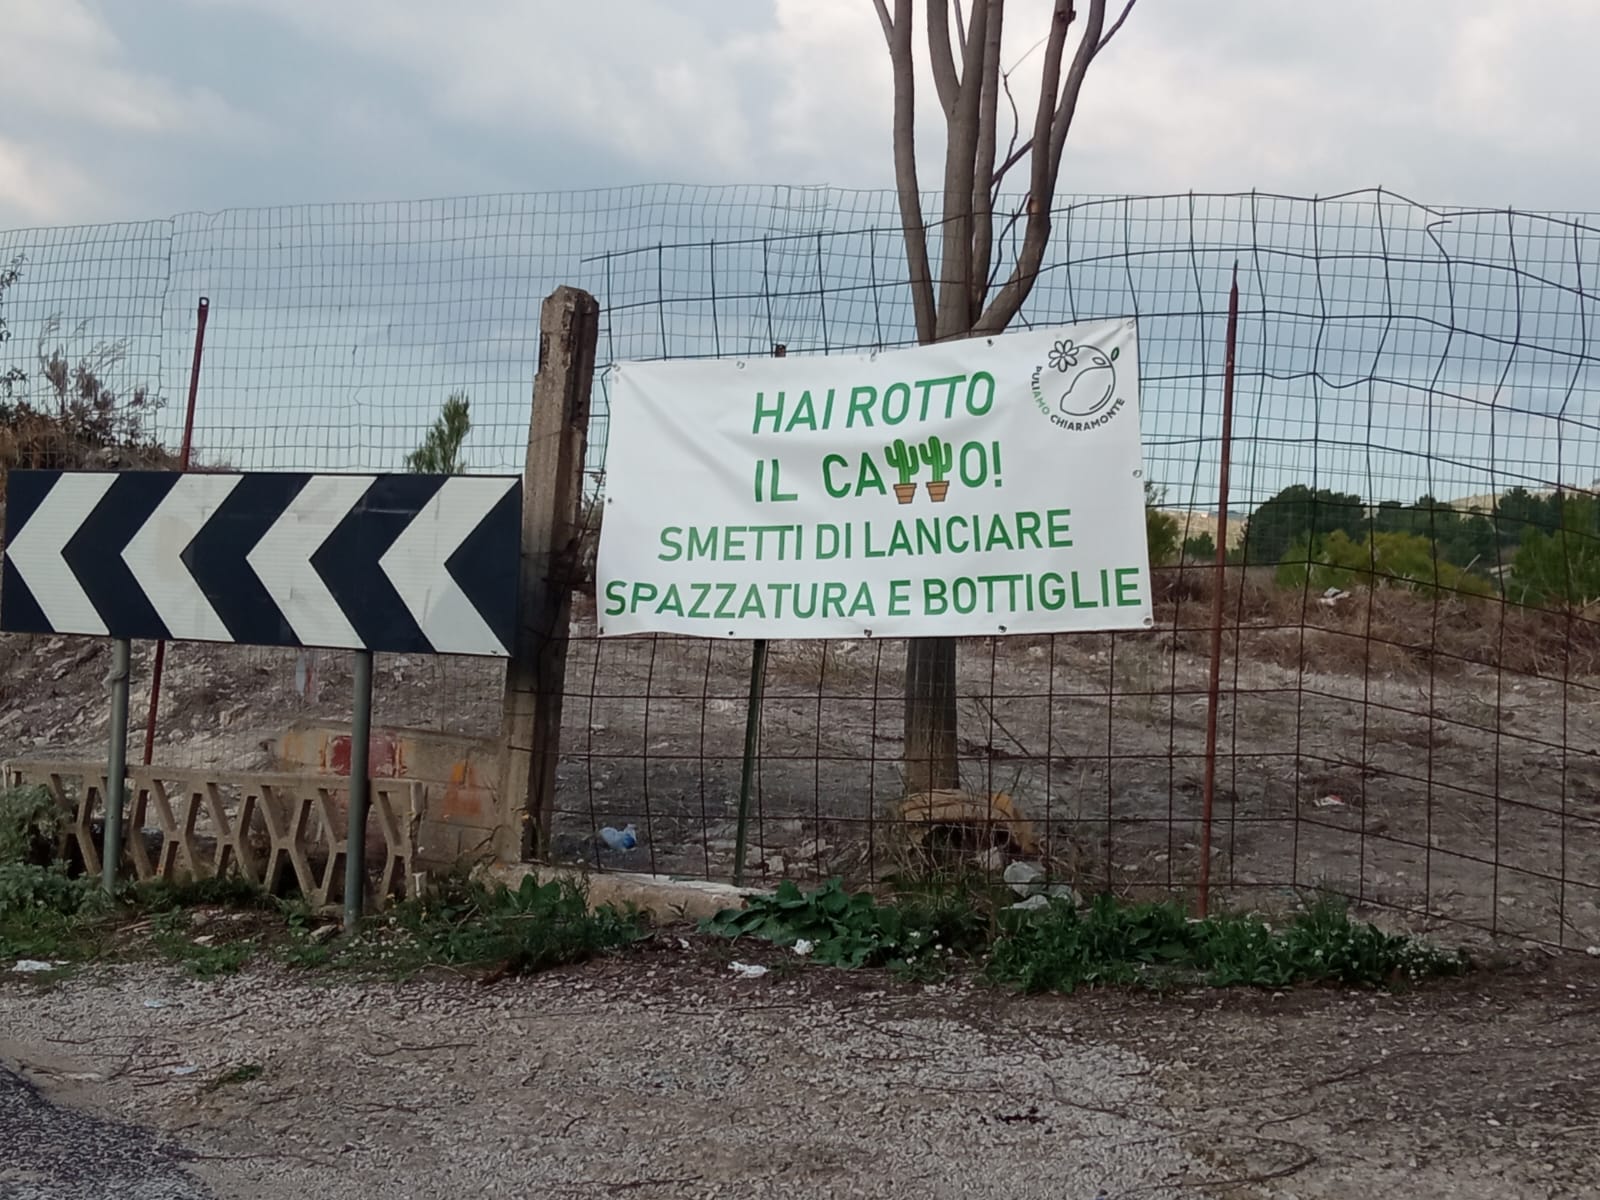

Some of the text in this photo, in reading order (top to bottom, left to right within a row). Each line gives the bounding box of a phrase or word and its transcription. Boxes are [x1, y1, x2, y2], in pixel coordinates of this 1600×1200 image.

[751, 370, 996, 433] HAI ROTTO
[1050, 397, 1125, 431] CHIARAMONTE
[754, 458, 799, 503] IL
[658, 508, 1073, 561] SMETTI DI LANCIARE
[605, 567, 1142, 619] SPAZZATURA E BOTTIGLIE
